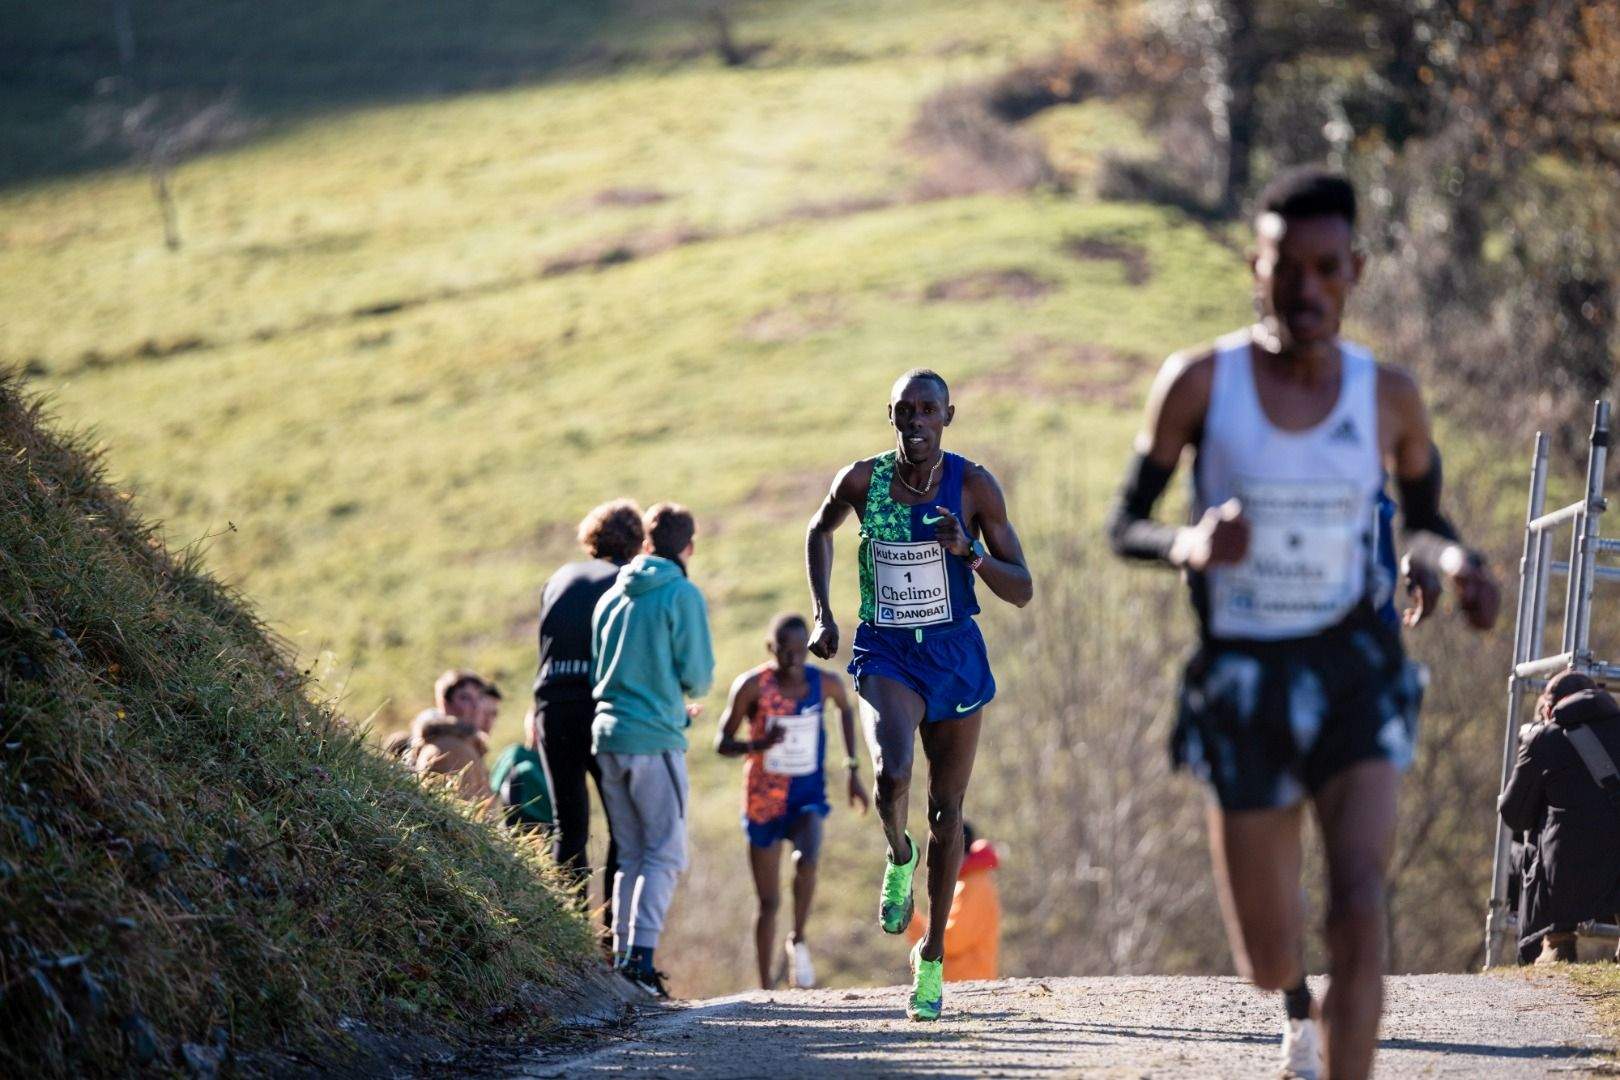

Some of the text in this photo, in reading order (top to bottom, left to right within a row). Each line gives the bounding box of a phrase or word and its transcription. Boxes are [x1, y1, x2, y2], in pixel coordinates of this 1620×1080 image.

[876, 547, 940, 561] kutxabank
[903, 572, 912, 583] 1
[881, 585, 941, 601] Chelimo
[896, 605, 945, 620] DANOBAT
